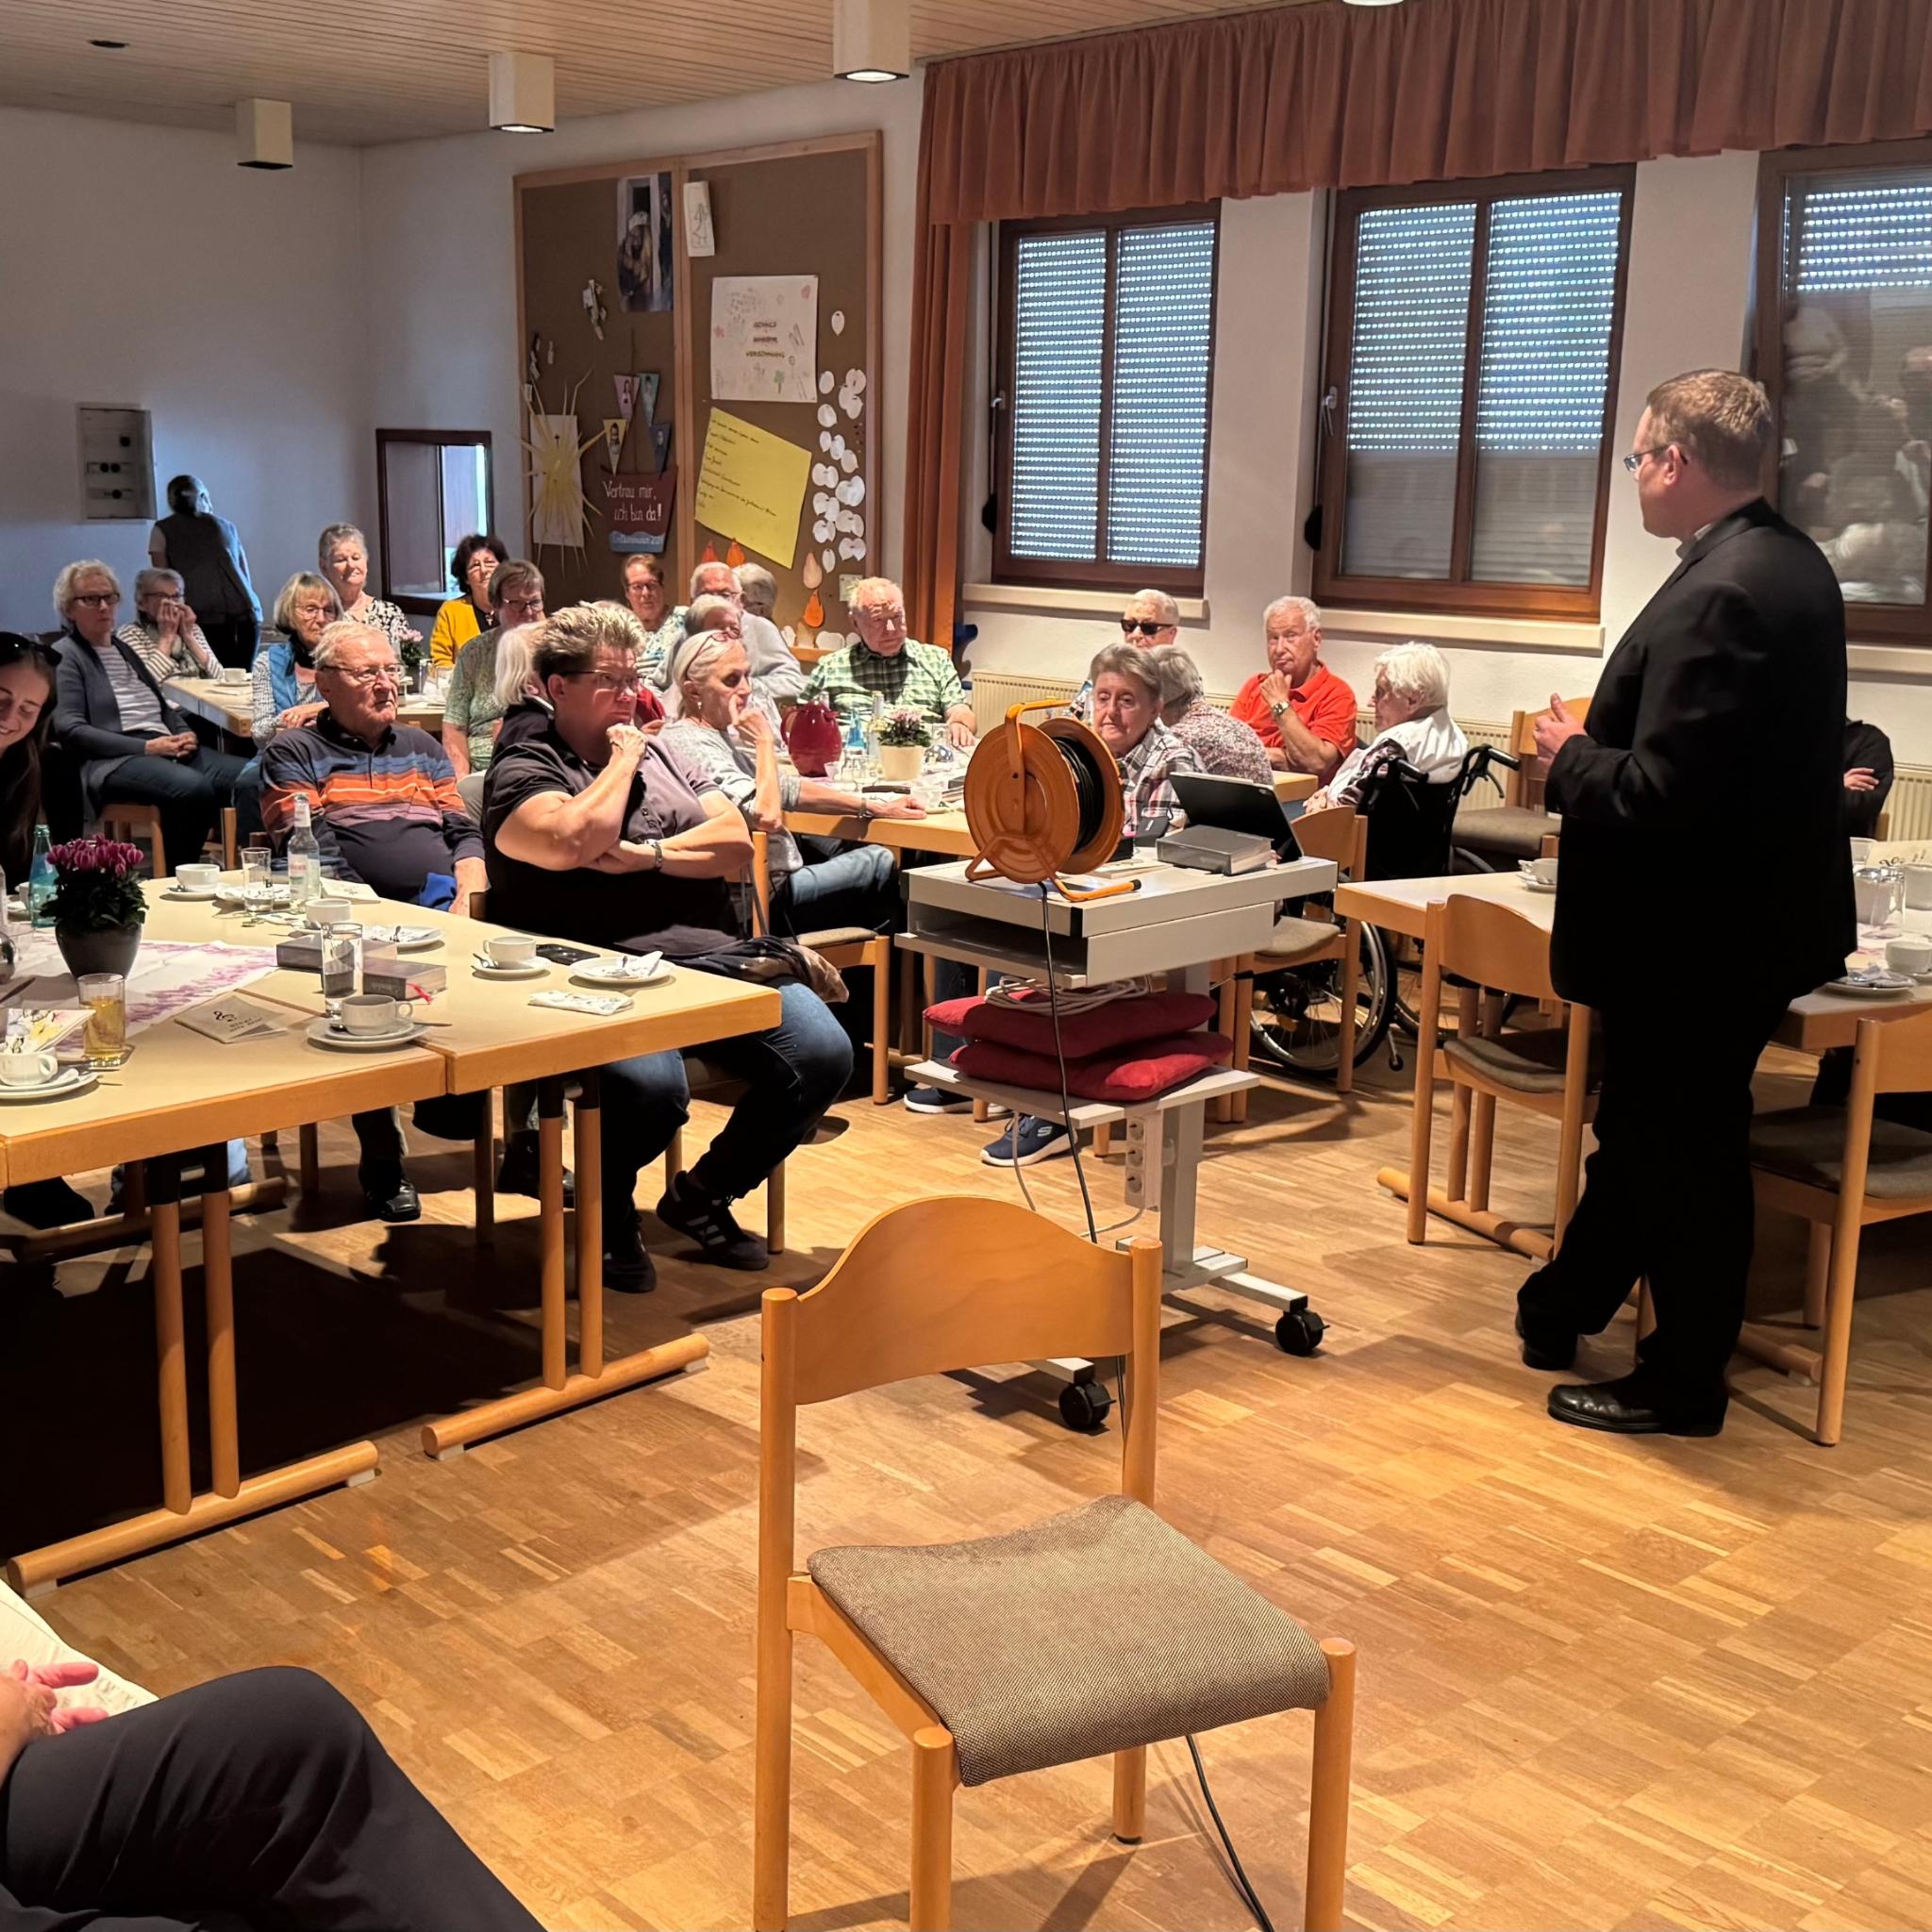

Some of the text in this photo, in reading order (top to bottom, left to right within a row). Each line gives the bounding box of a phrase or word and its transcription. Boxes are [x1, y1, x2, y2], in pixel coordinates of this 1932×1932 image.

[602, 479, 657, 500] Vertrau mir,
[614, 503, 662, 522] ich bin da!
